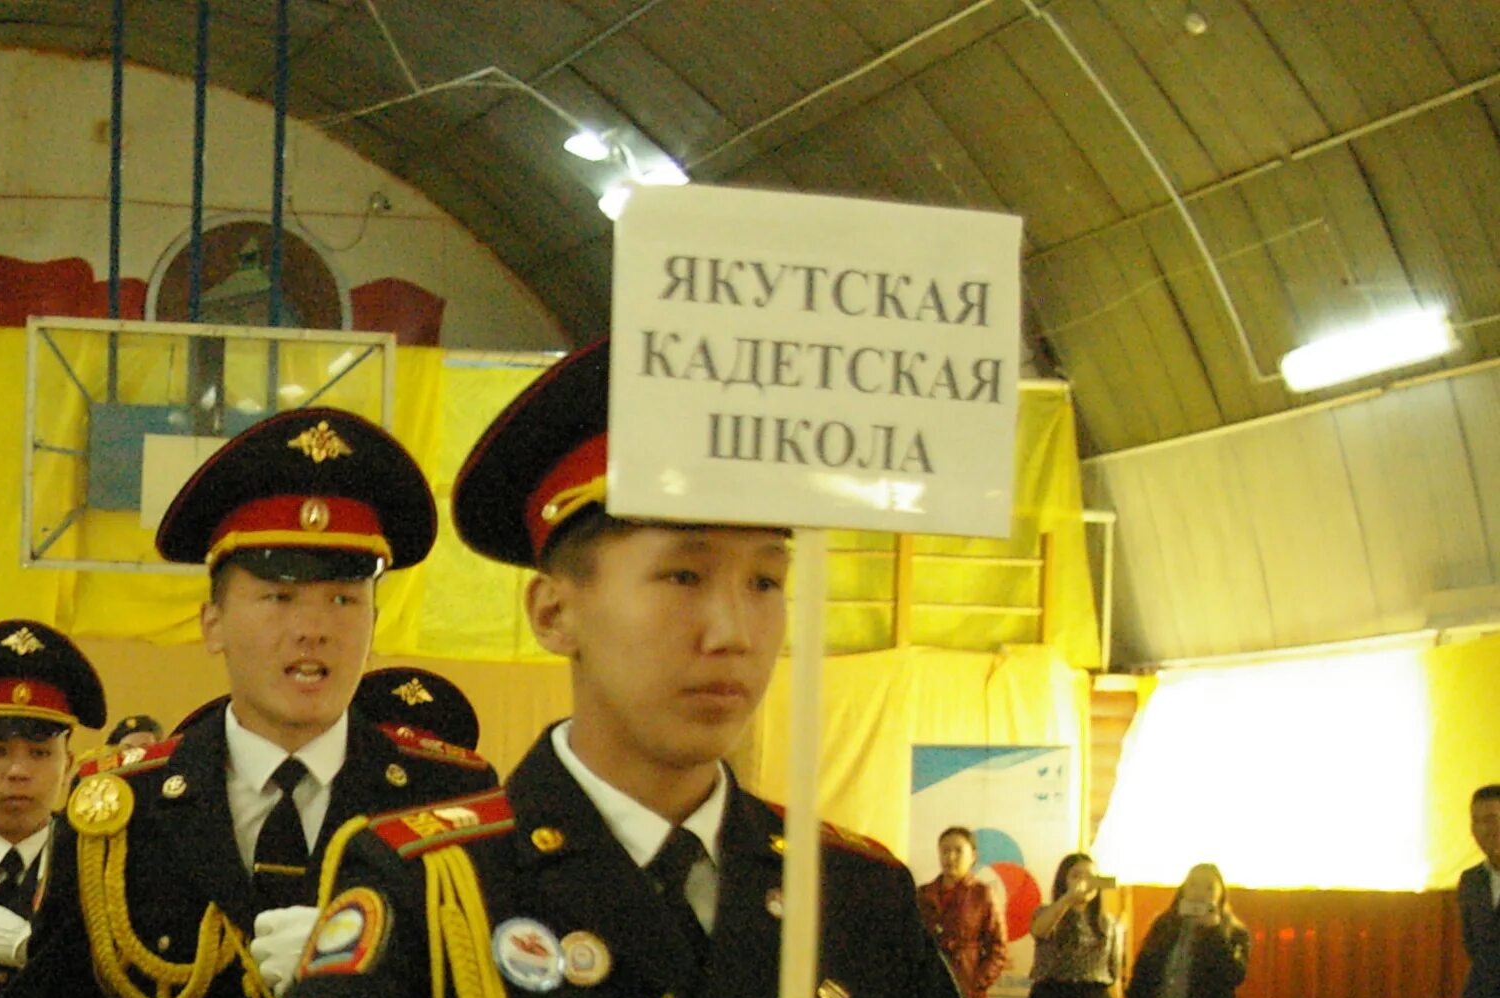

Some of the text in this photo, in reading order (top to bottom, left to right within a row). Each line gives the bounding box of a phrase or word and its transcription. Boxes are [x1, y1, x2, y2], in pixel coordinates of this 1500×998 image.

[659, 254, 991, 328] ЯКУТСКАЯ
[638, 330, 1003, 405] КАДЕТСКАЯ
[708, 412, 936, 475] ШКОЛА
